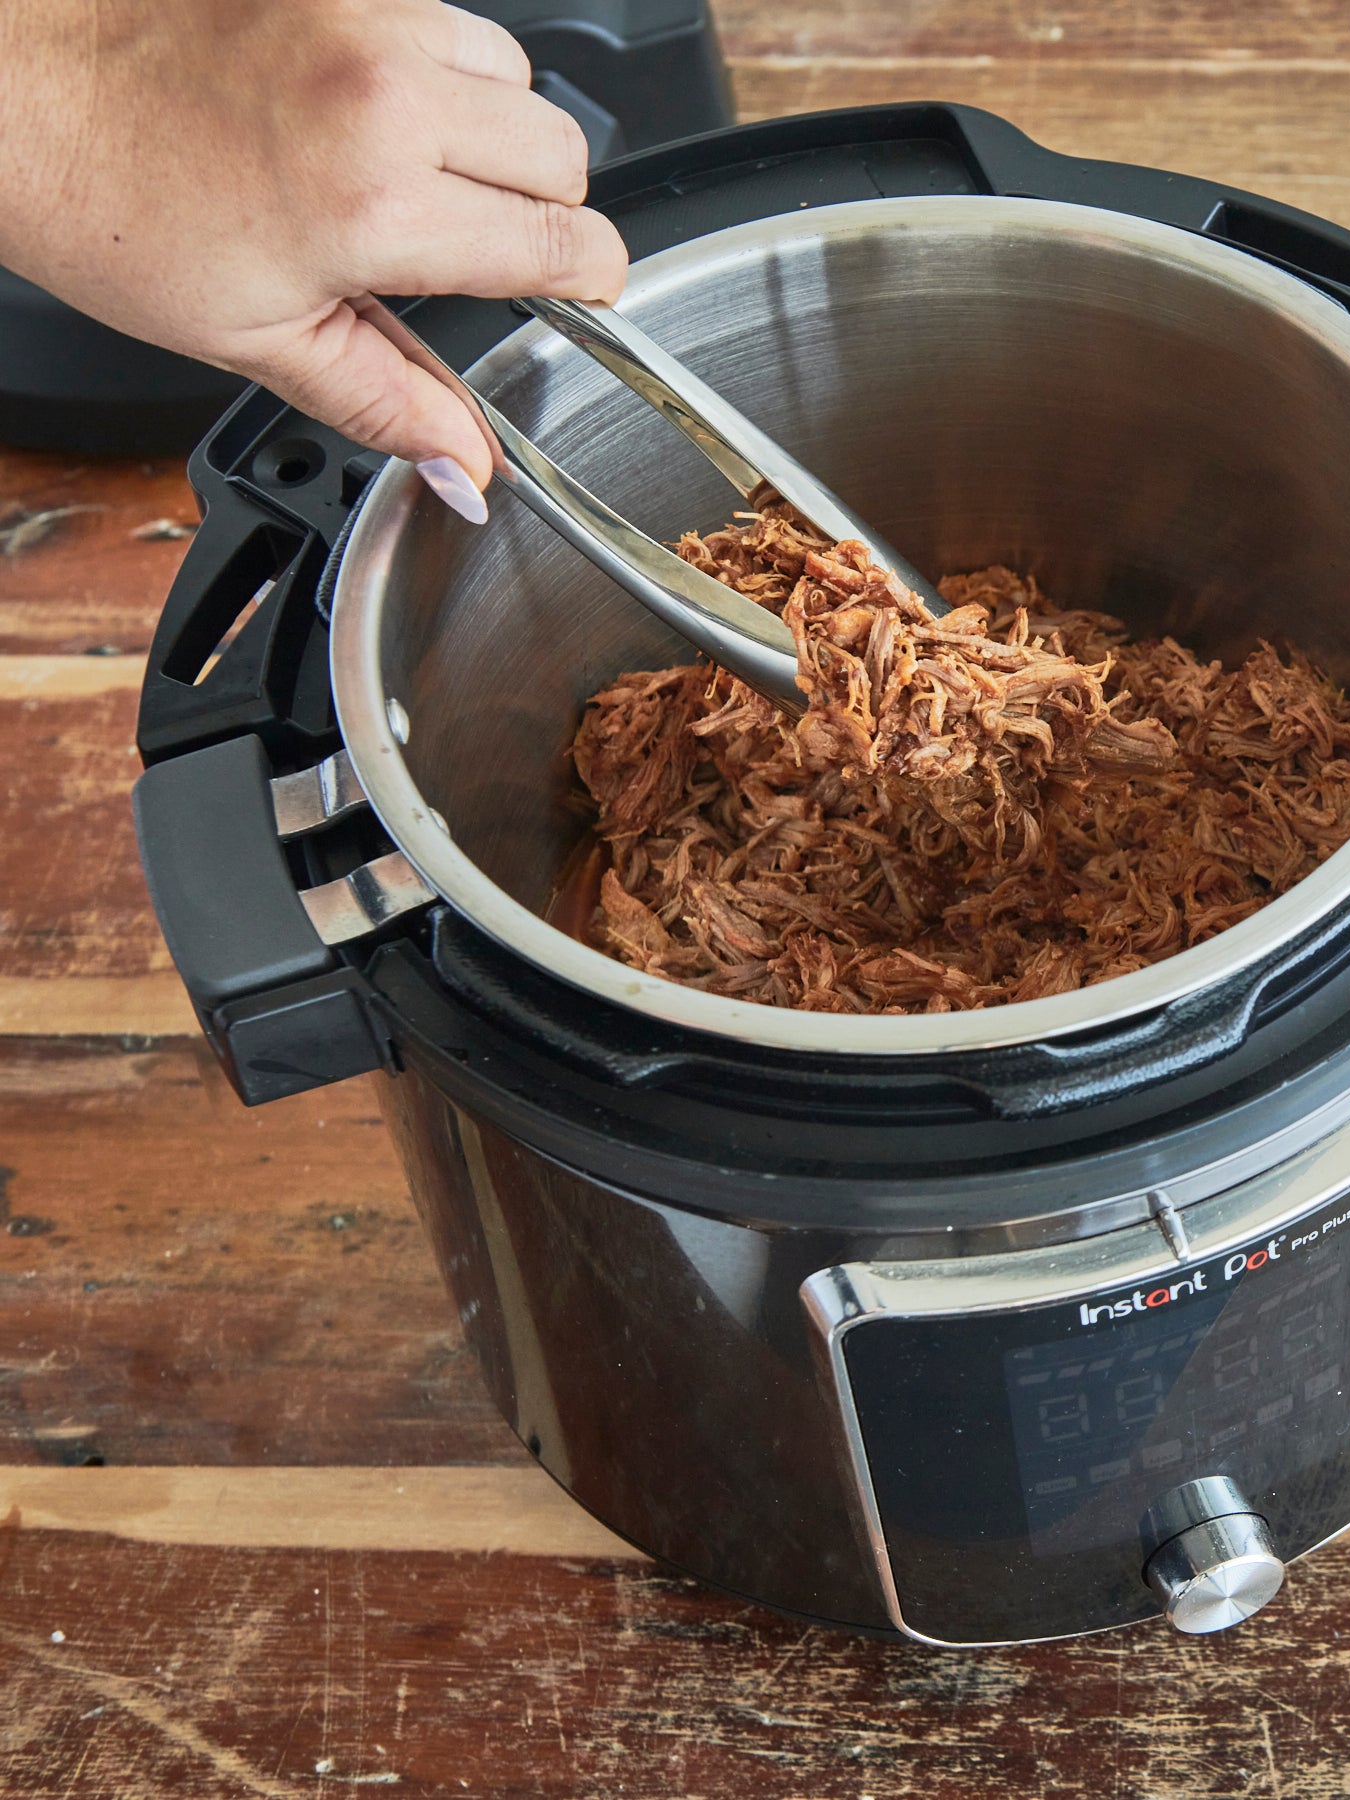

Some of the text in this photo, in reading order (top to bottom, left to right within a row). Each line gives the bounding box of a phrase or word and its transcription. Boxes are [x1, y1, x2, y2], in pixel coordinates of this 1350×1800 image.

[1079, 1271, 1208, 1326] Instant
[1223, 1239, 1281, 1281] Pot
[1291, 1228, 1319, 1251] Pro
